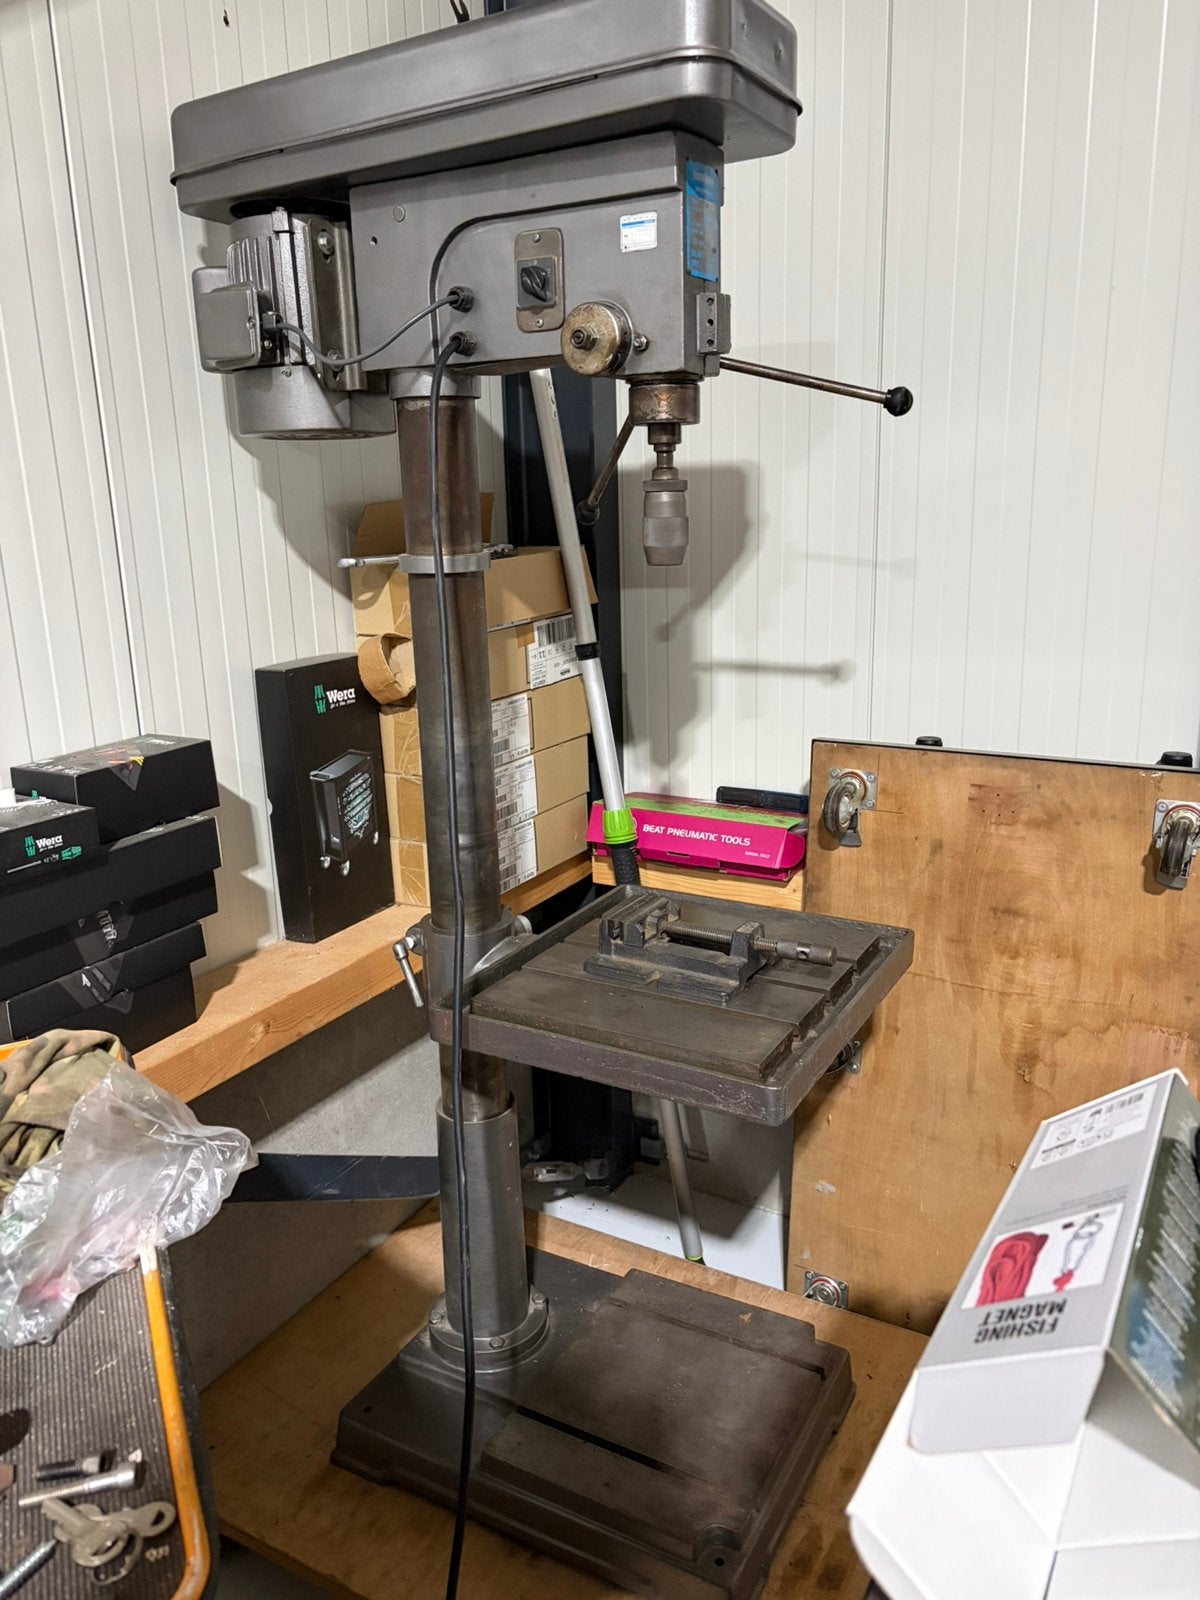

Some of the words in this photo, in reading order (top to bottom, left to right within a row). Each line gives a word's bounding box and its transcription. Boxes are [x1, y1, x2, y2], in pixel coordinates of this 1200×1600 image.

[325, 687, 356, 704] Wera
[35, 834, 63, 849] Wera
[642, 823, 665, 834] BEAT
[667, 827, 719, 842] PNEUMATIC
[720, 834, 751, 846] TOOLS
[979, 1298, 1067, 1327] MAGNET
[974, 1317, 1059, 1345] FISHING
